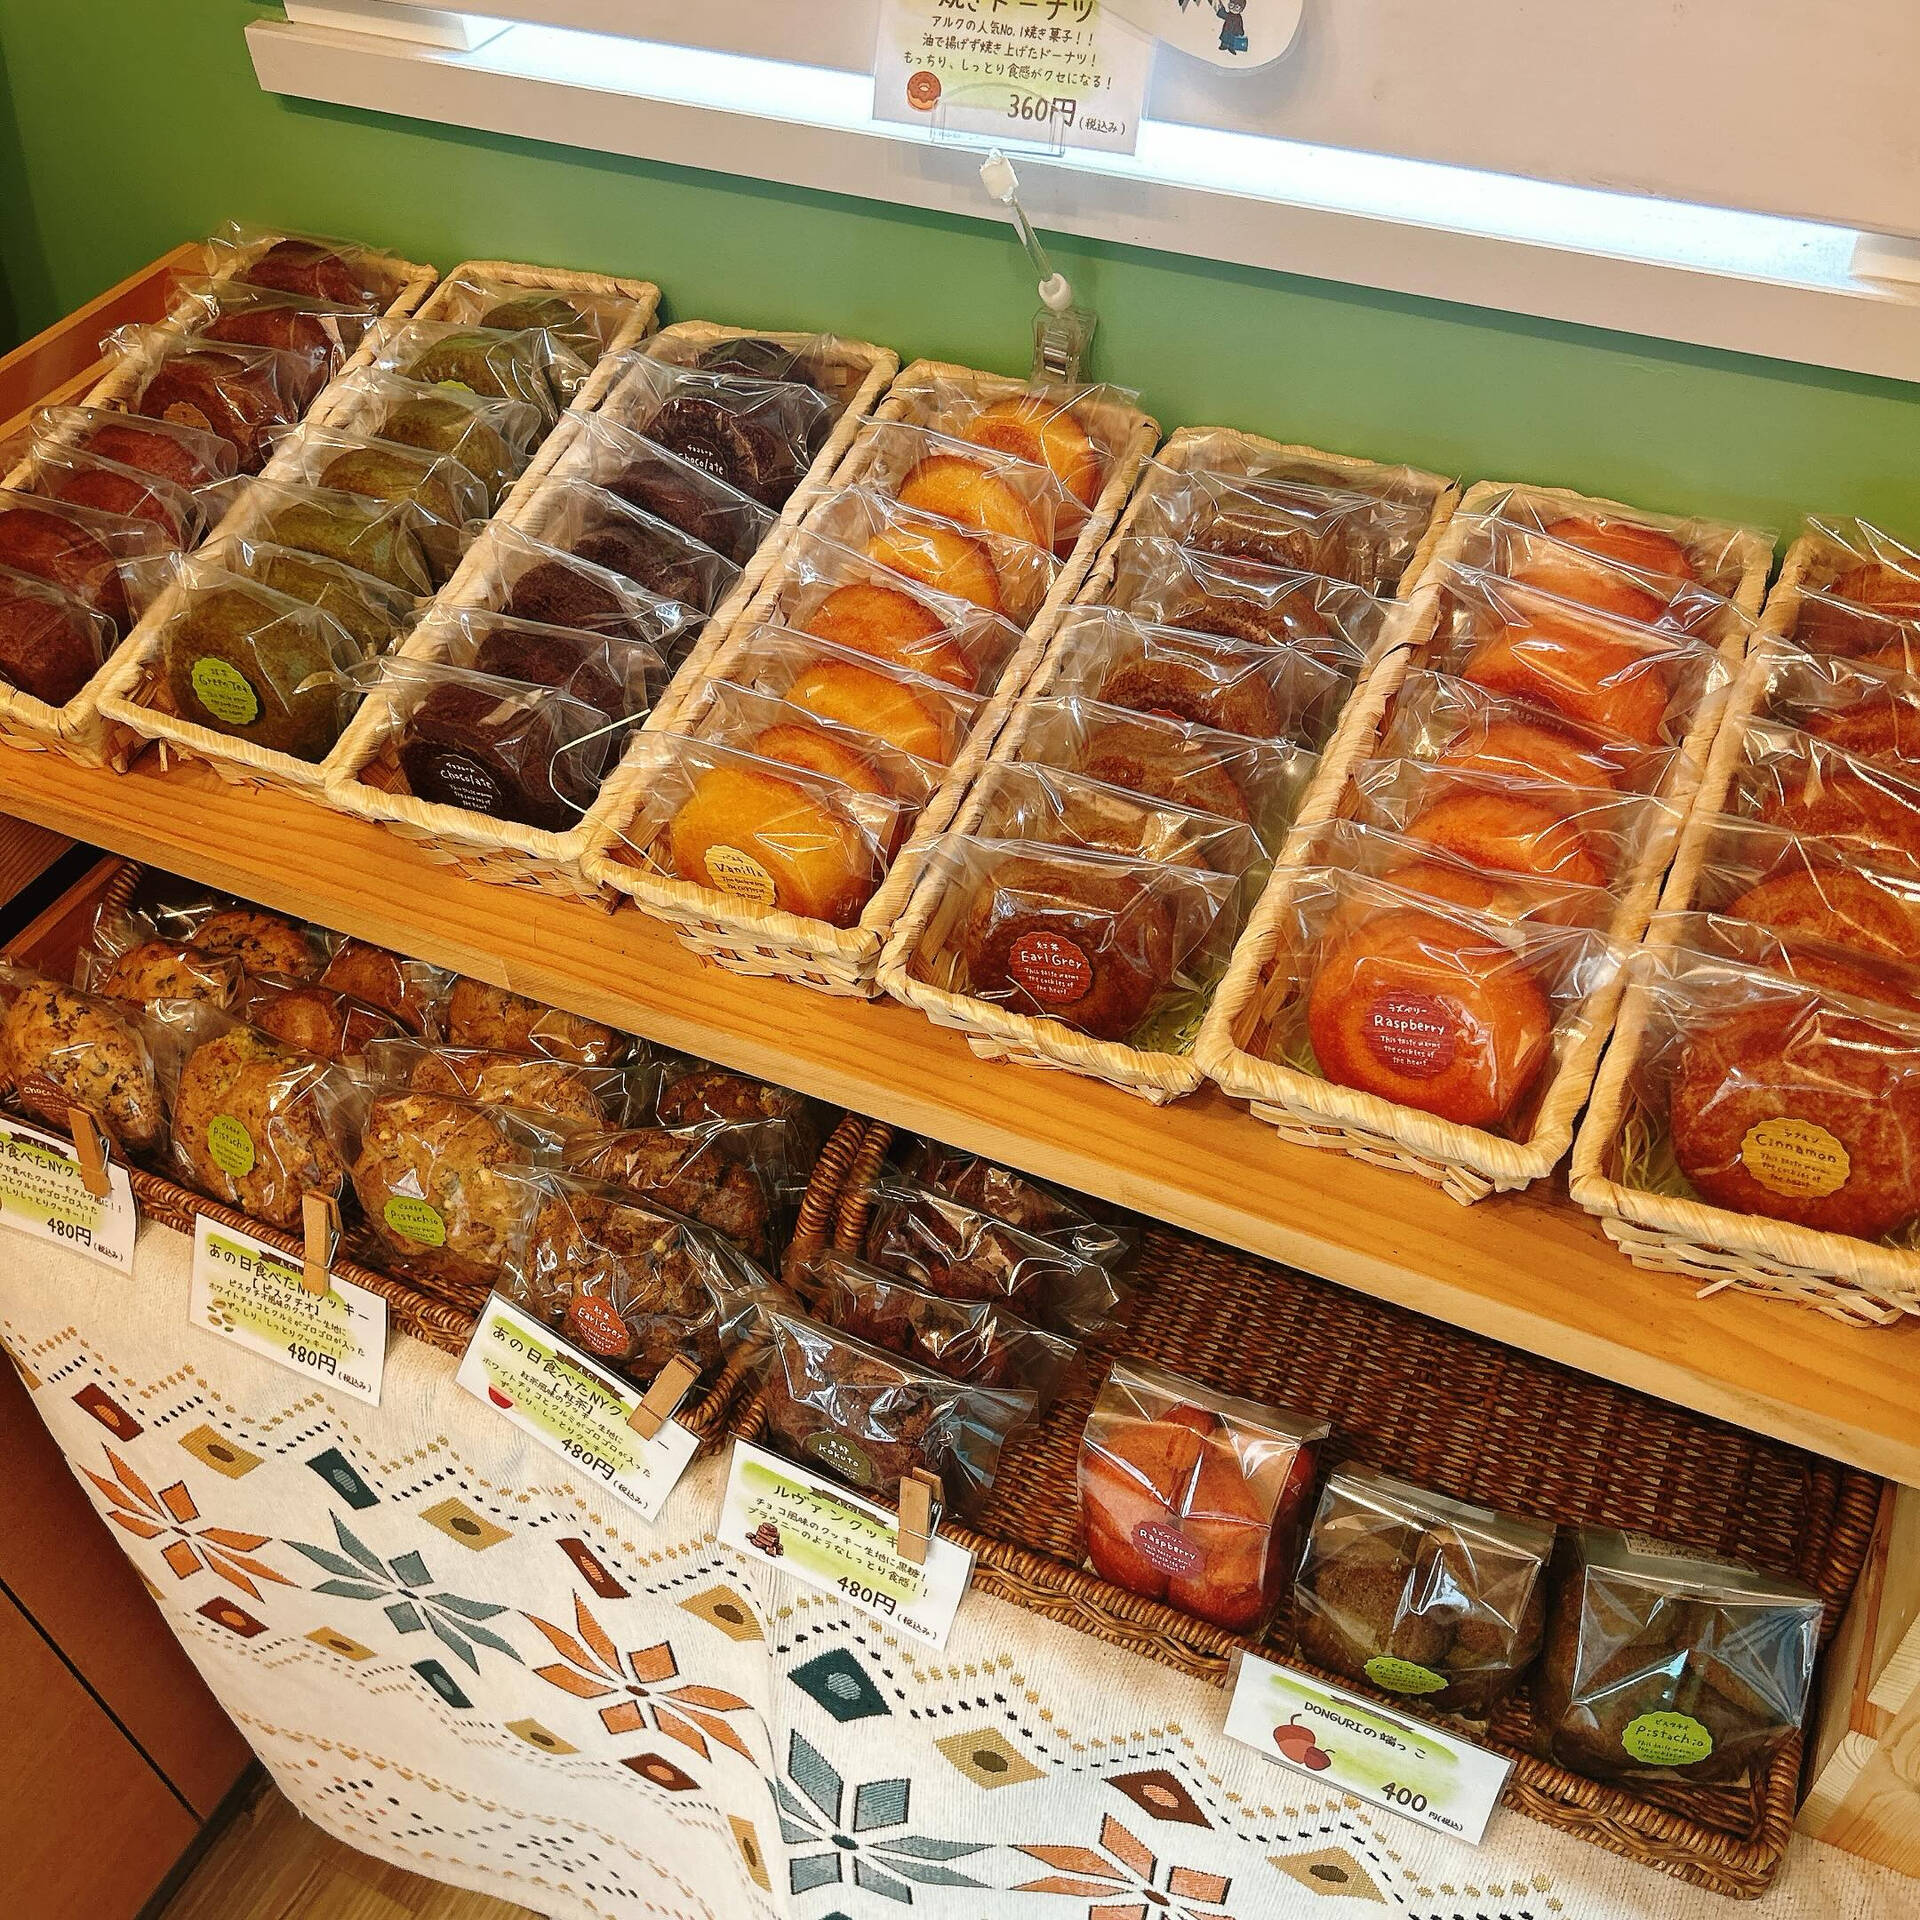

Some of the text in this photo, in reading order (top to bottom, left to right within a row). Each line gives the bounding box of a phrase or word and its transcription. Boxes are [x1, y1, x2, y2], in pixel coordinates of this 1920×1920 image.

[922, 32, 1097, 67] 油で揚げず焼き上げたドーナツ！
[904, 51, 1112, 90] もっちり、しっとり食感がクセになる！
[1007, 94, 1077, 127] 360円
[714, 862, 763, 878] Vanilla
[1021, 950, 1082, 969] Earl Grey
[1374, 1014, 1445, 1036] Raspberry
[0, 1141, 84, 1178] 食べたNYク
[1755, 1133, 1837, 1163] Cinnamon
[47, 1218, 92, 1247] 480円
[288, 1342, 337, 1376] 480円
[492, 1326, 669, 1450] あの日食べたNYクー
[561, 1438, 616, 1481] 480円
[1139, 1529, 1196, 1560] Raspberry
[837, 1576, 897, 1616] 480円
[1635, 1725, 1704, 1747] Pistachio
[1381, 1782, 1428, 1812] 400
